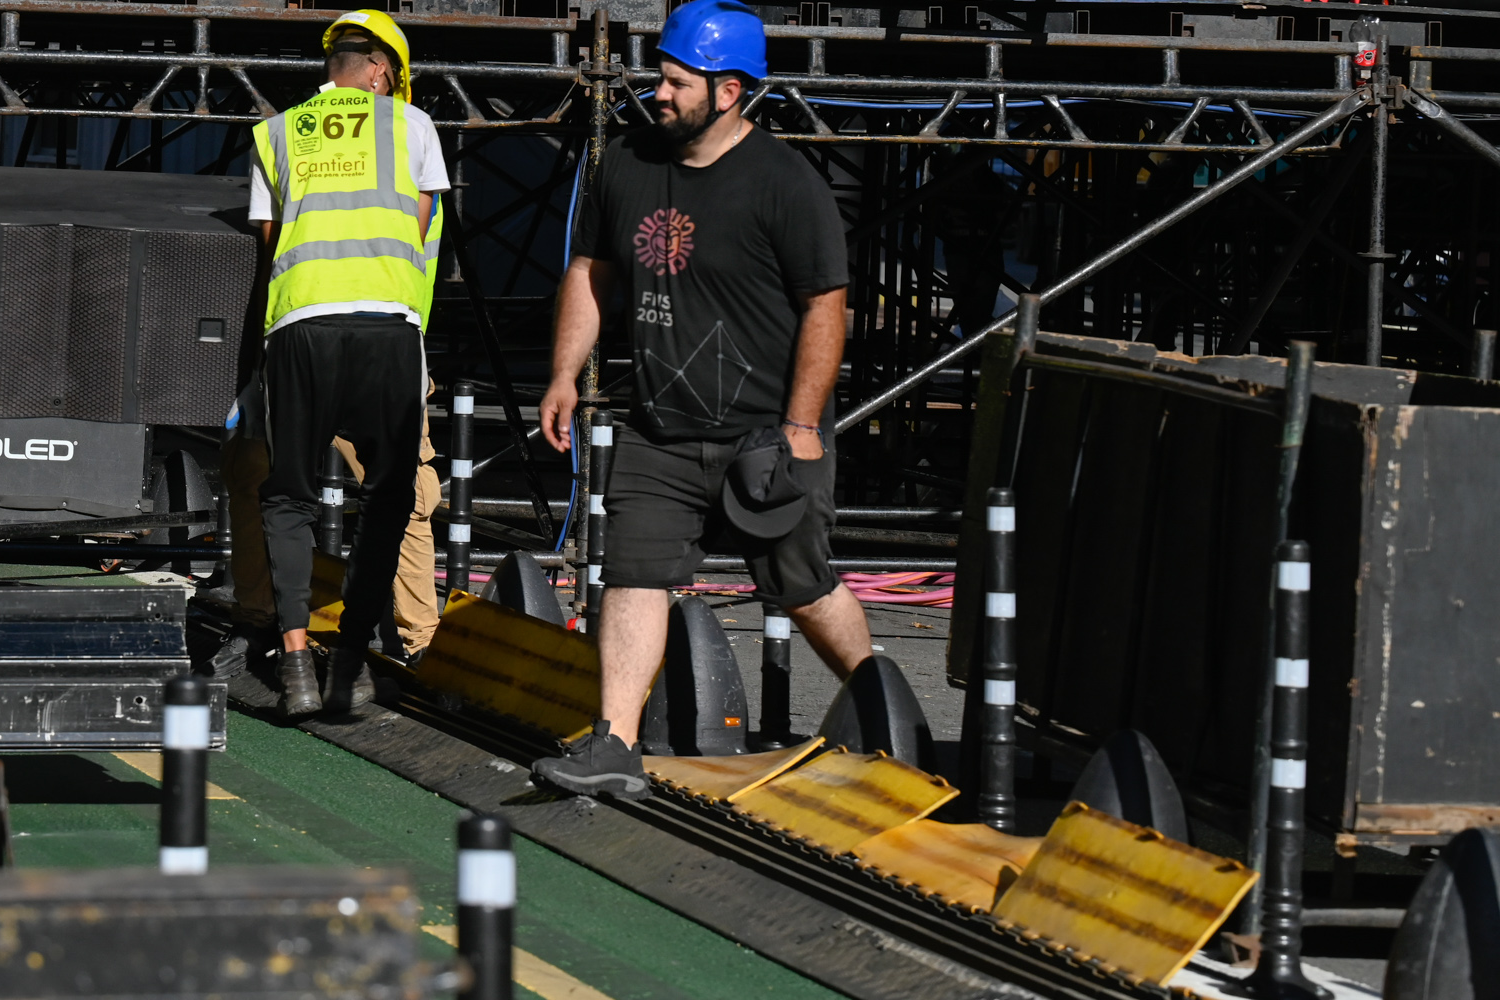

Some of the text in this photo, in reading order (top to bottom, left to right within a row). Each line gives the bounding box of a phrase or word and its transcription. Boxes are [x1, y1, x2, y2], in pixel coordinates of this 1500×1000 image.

[330, 97, 369, 106] CARGA
[323, 112, 369, 140] 67
[296, 156, 365, 177] Cantieri
